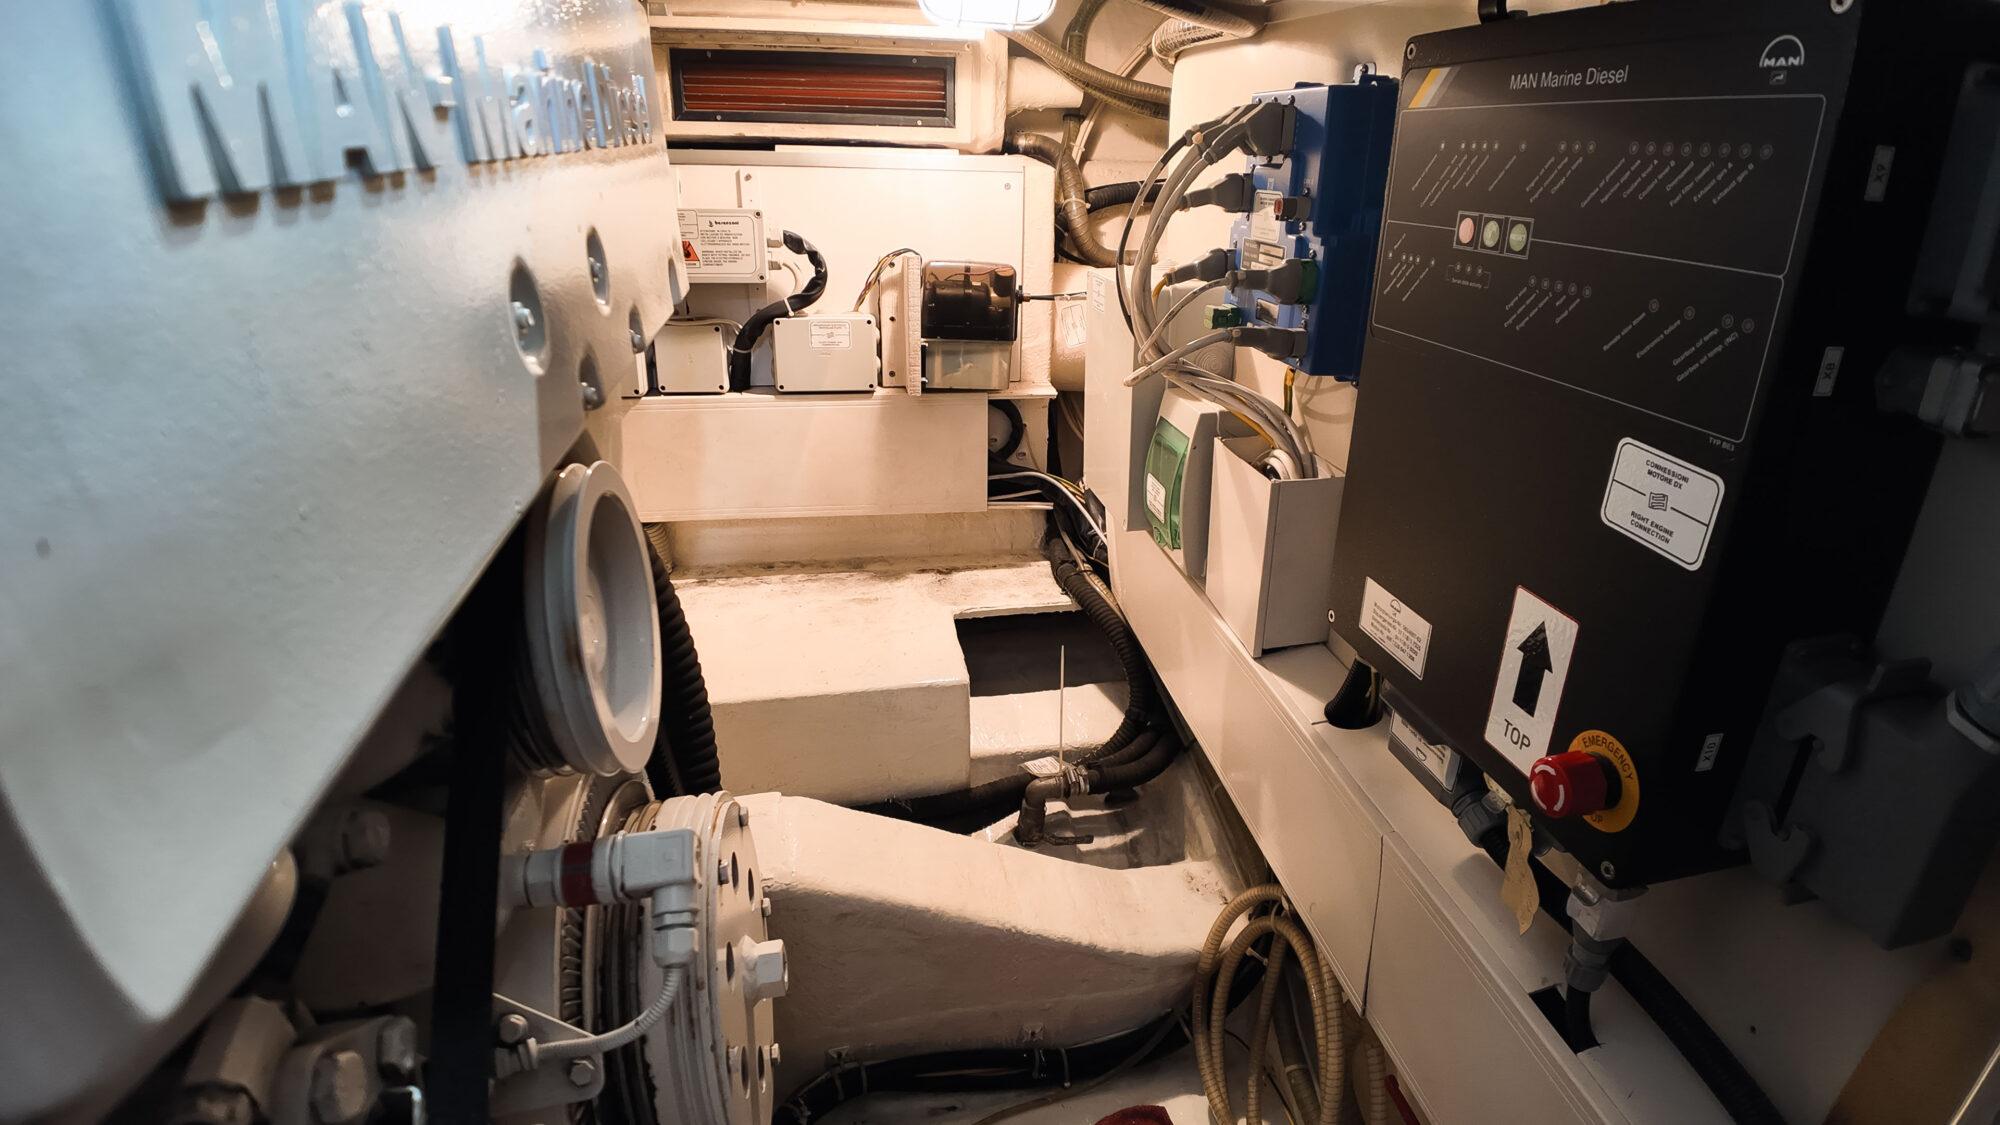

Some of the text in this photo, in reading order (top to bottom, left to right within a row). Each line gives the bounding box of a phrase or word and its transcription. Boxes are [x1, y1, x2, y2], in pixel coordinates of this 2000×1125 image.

[1763, 56, 1800, 67] MAN
[1509, 65, 1629, 90] MAN Marine Diesel
[1874, 164, 1886, 183] X9
[1823, 362, 1836, 380] X8
[1645, 459, 1690, 483] CONNESSIONI
[1647, 469, 1683, 490] MOTORE DX
[1630, 511, 1674, 538] RIGHT ENGINE
[1630, 519, 1670, 545] CONNECTION
[1504, 719, 1531, 750] TOP
[1581, 735, 1634, 780] EMERGENCY
[1703, 742, 1716, 762] X10
